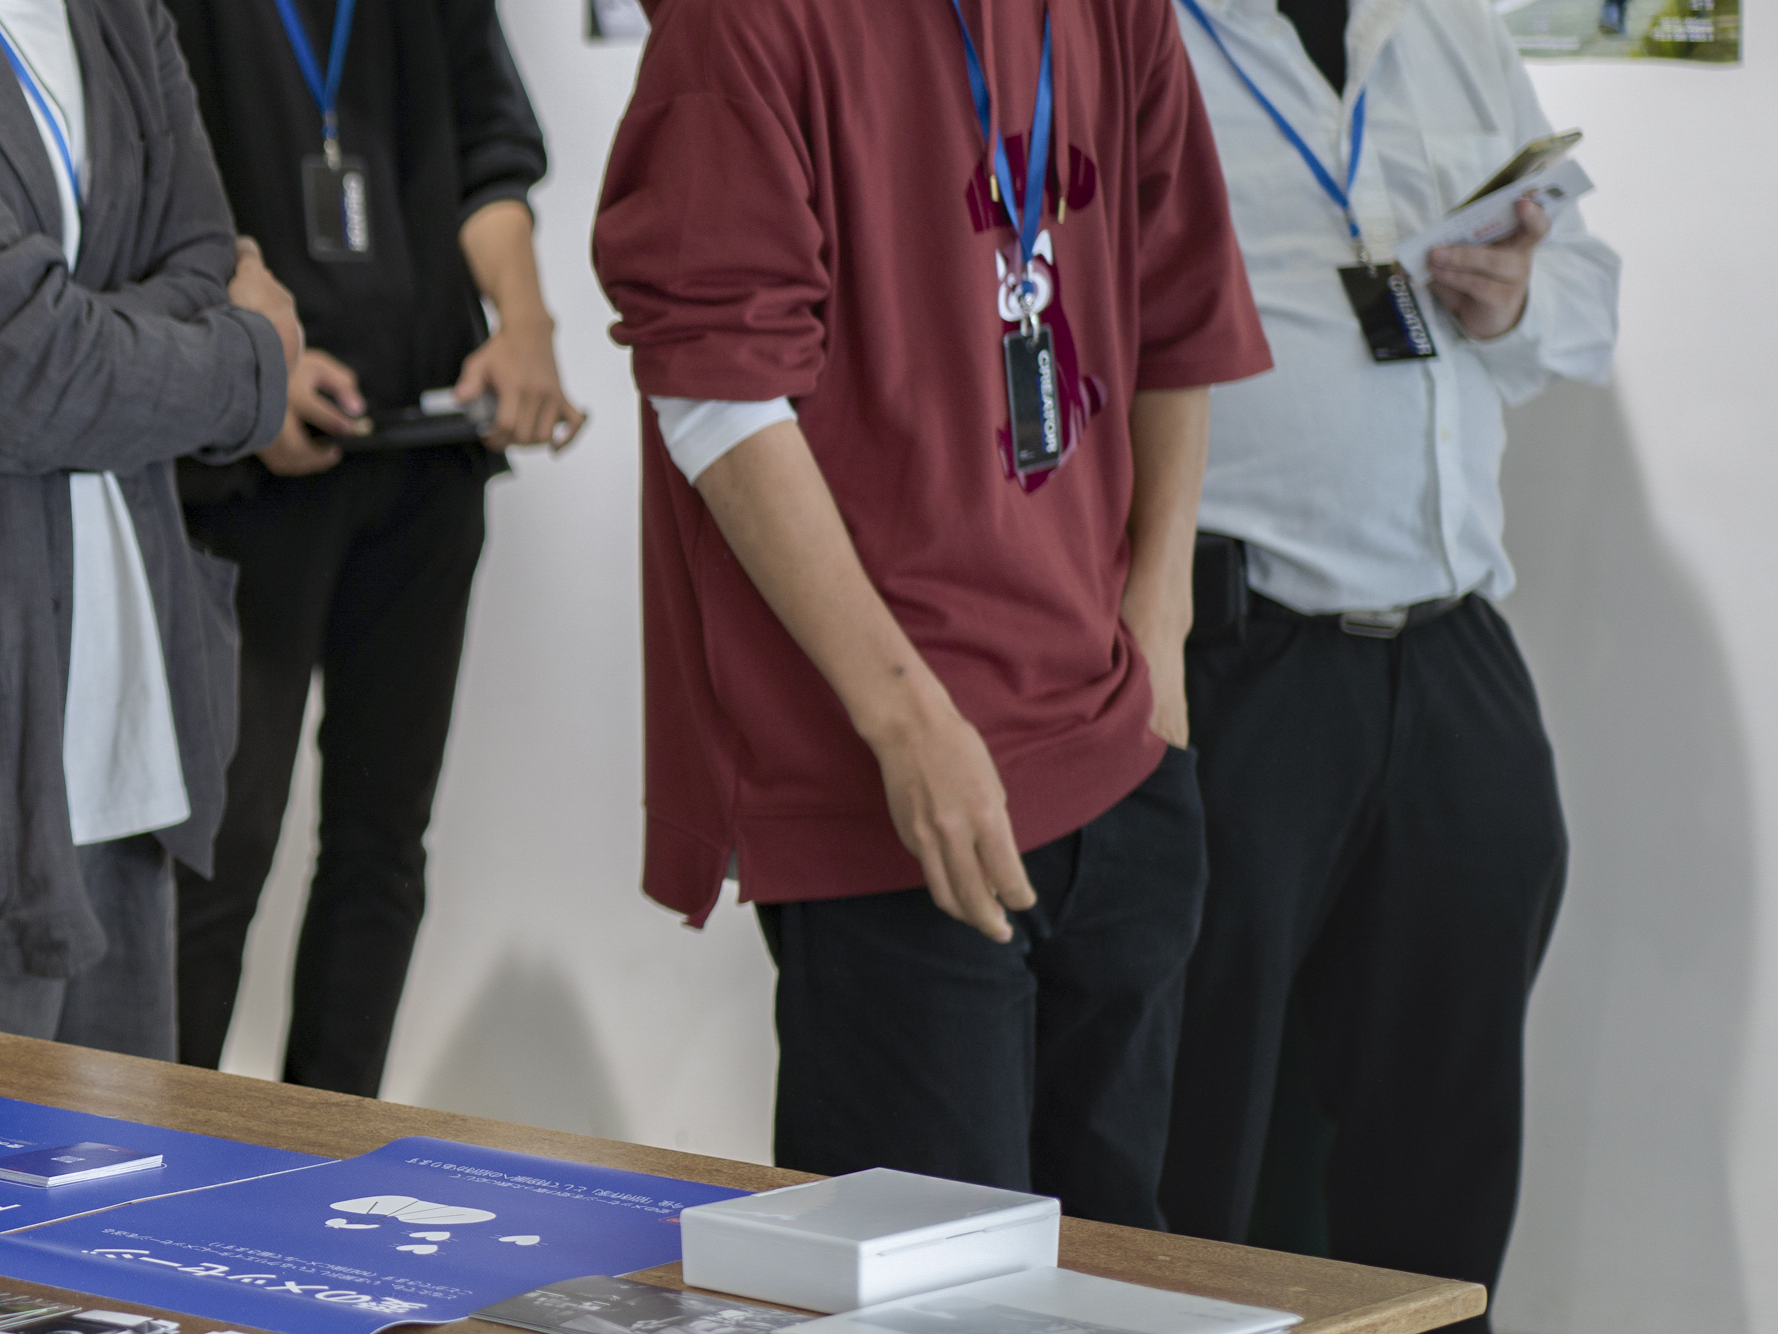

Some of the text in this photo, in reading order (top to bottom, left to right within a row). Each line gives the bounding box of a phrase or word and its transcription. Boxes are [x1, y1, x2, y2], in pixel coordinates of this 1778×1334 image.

[1037, 349, 1059, 454] CREATOR
[80, 1247, 428, 1314] 愛のメッセージ
